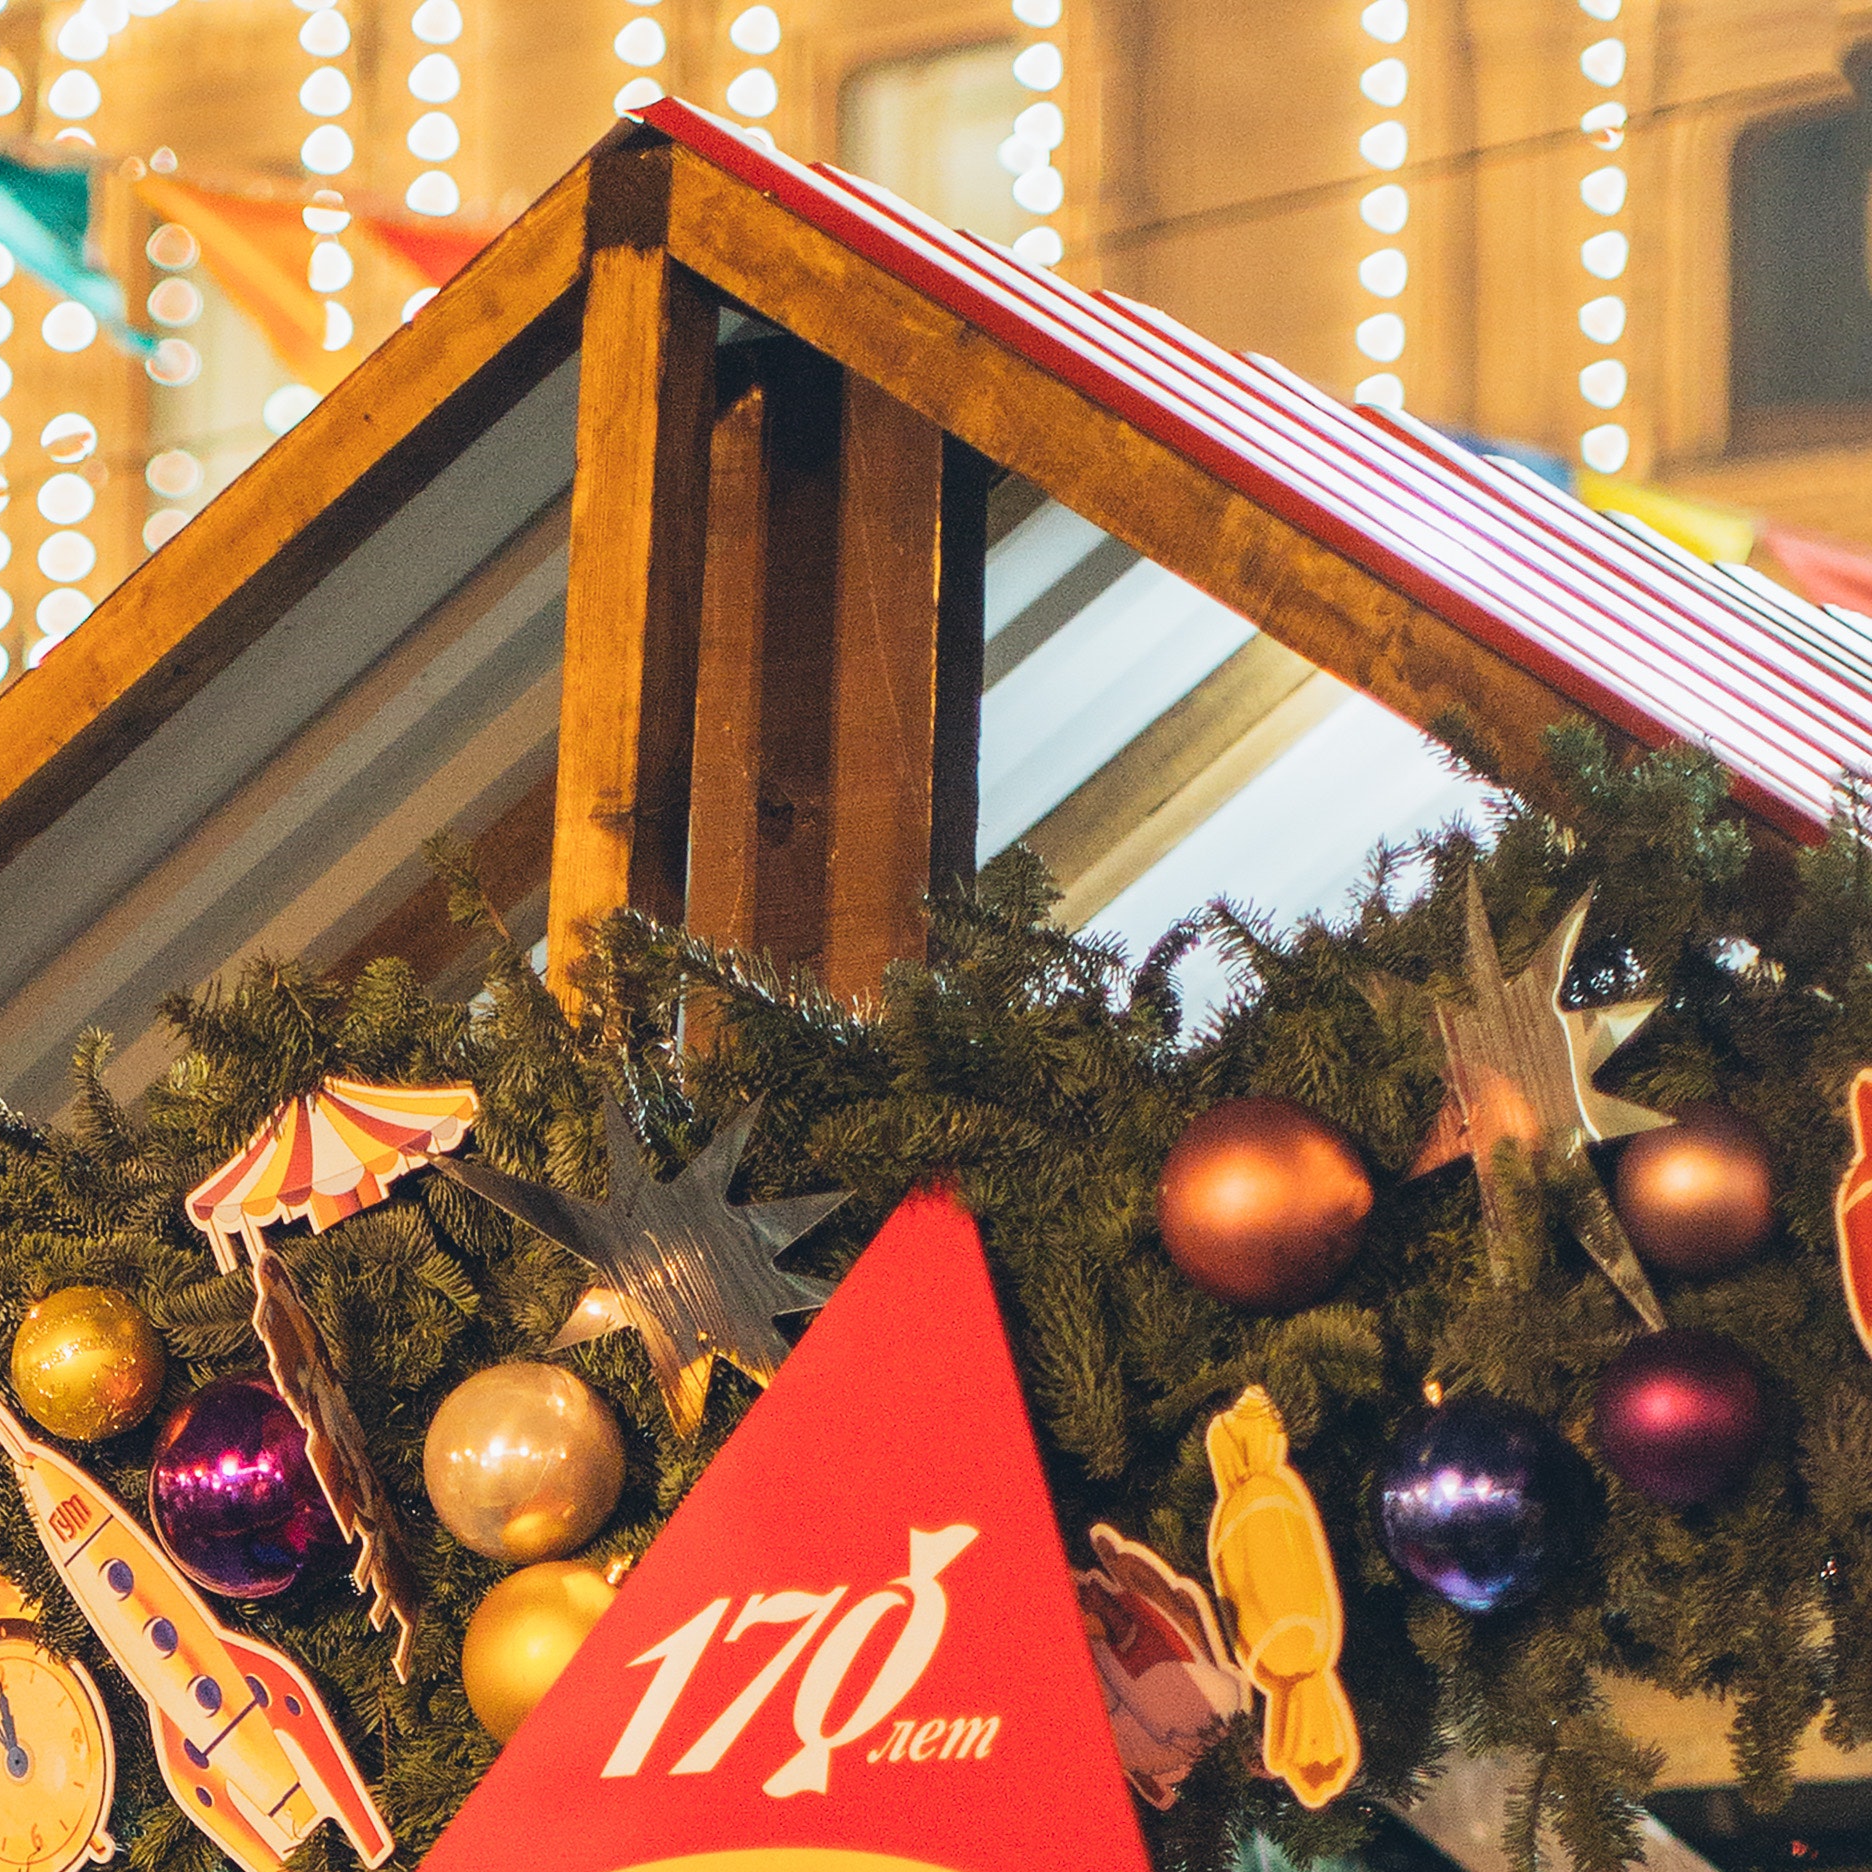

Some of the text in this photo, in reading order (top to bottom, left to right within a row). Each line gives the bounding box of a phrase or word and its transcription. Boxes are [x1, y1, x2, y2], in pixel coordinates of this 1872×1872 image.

[601, 1524, 1002, 1799] 170 лет
[30, 1821, 44, 1850] 6
